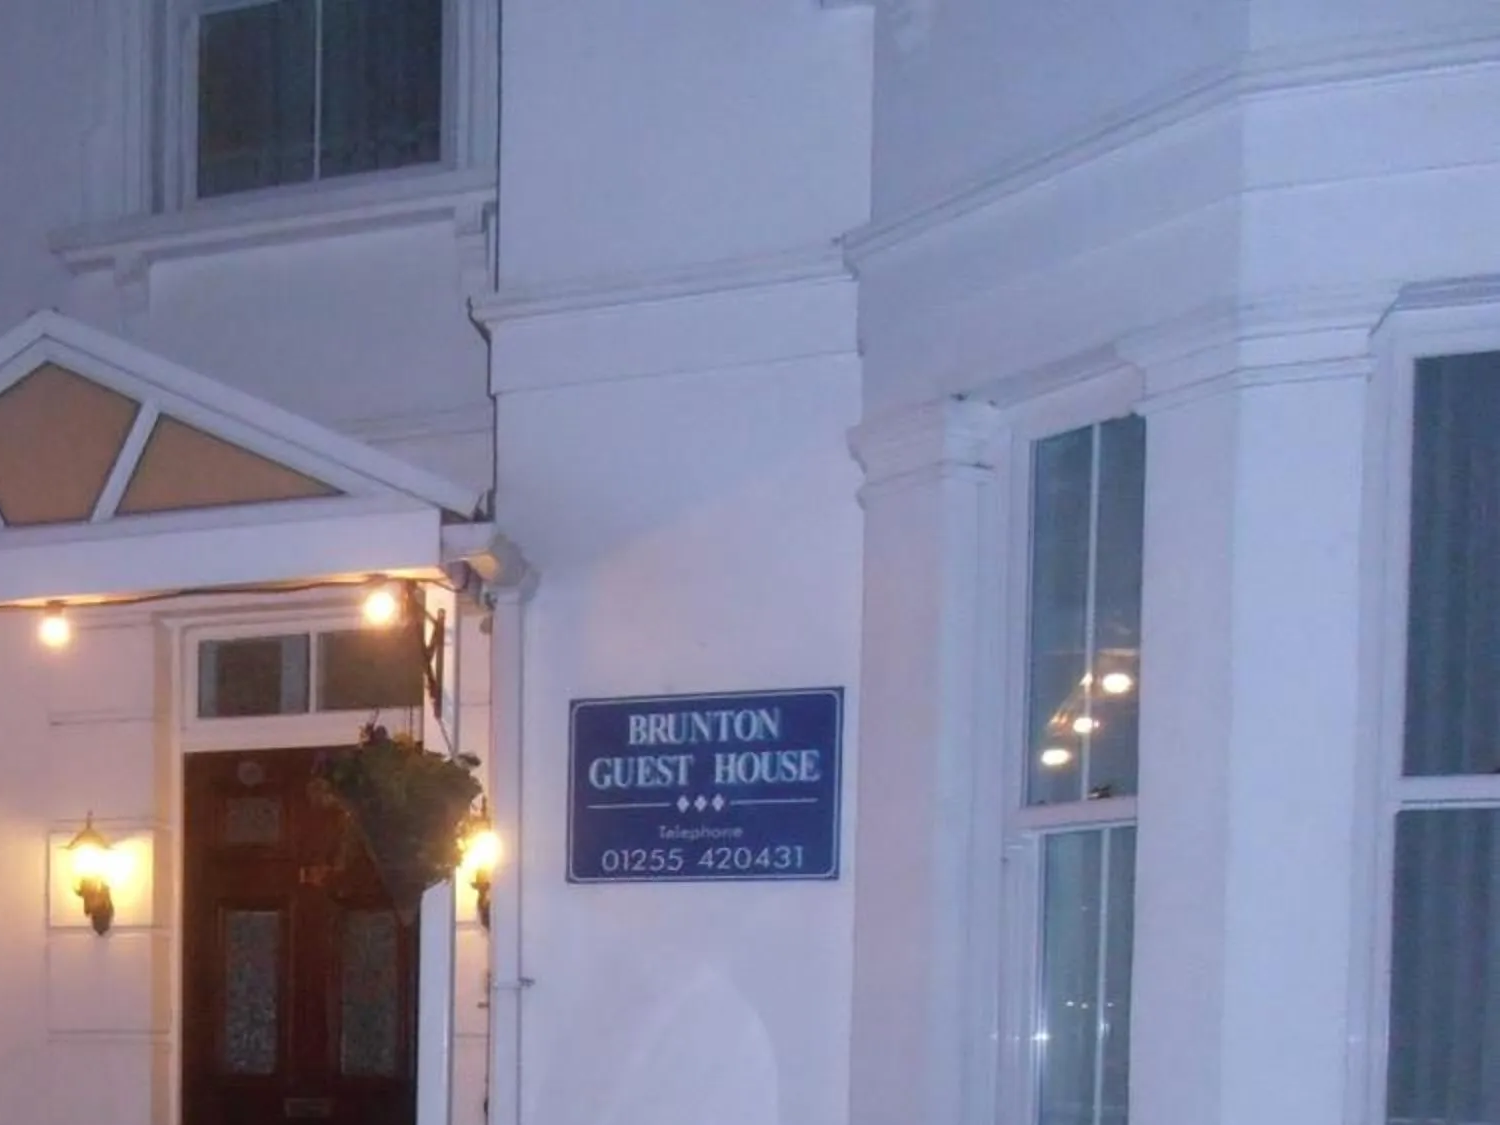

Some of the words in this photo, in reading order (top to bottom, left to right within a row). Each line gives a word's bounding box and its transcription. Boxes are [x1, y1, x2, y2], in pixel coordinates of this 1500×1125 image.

[628, 707, 781, 745] BRUNTON
[588, 754, 695, 790] GUEST
[713, 749, 821, 785] HOUSE
[658, 824, 744, 842] Telephone
[601, 848, 685, 872] 01255
[697, 845, 804, 870] 420431
